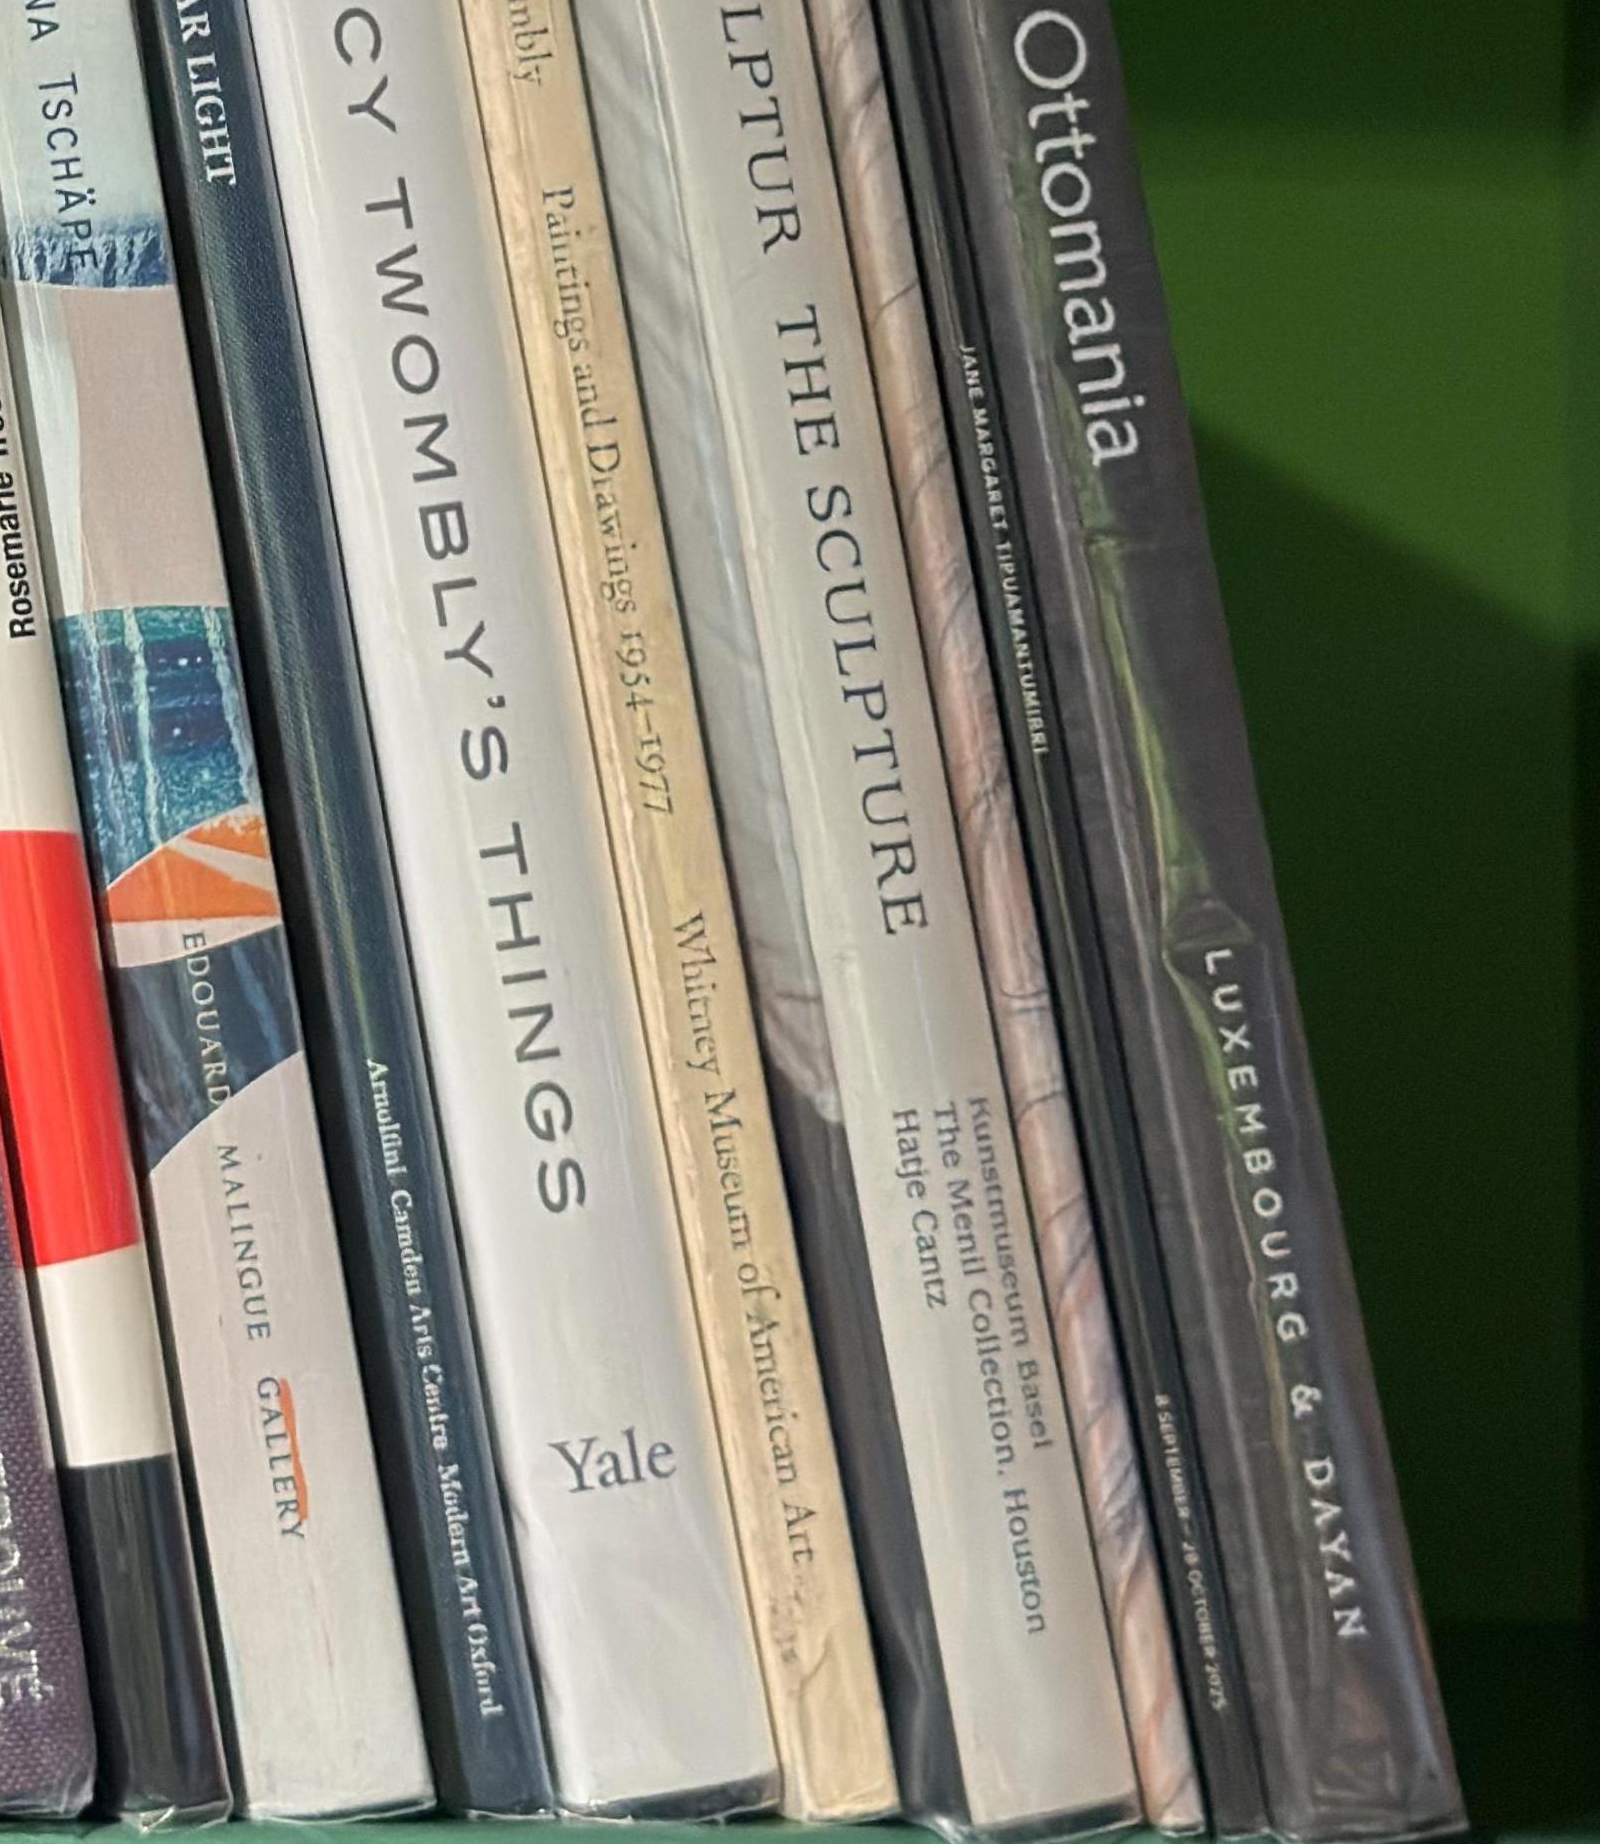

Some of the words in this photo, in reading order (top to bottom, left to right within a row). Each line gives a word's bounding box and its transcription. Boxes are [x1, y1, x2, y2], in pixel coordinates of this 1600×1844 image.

[38, 72, 99, 273] TSCHÄPE
[186, 49, 237, 187] LIGHT
[1013, 10, 1148, 465] Ottomania
[540, 184, 592, 352] Paintings
[568, 362, 616, 432] and
[776, 303, 841, 458] THE
[333, 7, 396, 133] CY
[479, 820, 586, 1215] THINGS
[586, 439, 637, 613] Drawings
[957, 344, 982, 399] JANE
[977, 408, 1008, 532] MARGARET
[996, 541, 1049, 755] TIPUAMANTUMIRRI
[808, 483, 929, 938] SCULPTURE
[182, 931, 230, 1108] EDOUARD
[217, 1144, 271, 1341] MALINGUE
[257, 1376, 306, 1543] GALLERY
[673, 912, 721, 1077] Whitney
[703, 1090, 750, 1249] Museum
[745, 1308, 798, 1486] American
[782, 1500, 818, 1567] Art
[893, 1109, 926, 1201] Hatje
[910, 1208, 947, 1310] Cantz
[969, 1095, 1029, 1348] Kunstmuseum
[1018, 1359, 1050, 1450] Basel
[1204, 949, 1306, 1344] LUXEMBOURG
[366, 1057, 405, 1179] Arnolfini
[392, 1188, 421, 1296] Camden
[409, 1302, 434, 1357] Arts
[423, 1363, 449, 1451] Centre
[438, 1461, 471, 1568] Modern
[468, 1619, 503, 1718] Oxford
[550, 1428, 676, 1495] Yale
[933, 1100, 961, 1169] The
[947, 1176, 986, 1279] Menil
[1003, 1487, 1046, 1636] Houston
[1291, 1384, 1322, 1418] &
[1306, 1457, 1367, 1641] DAYAN
